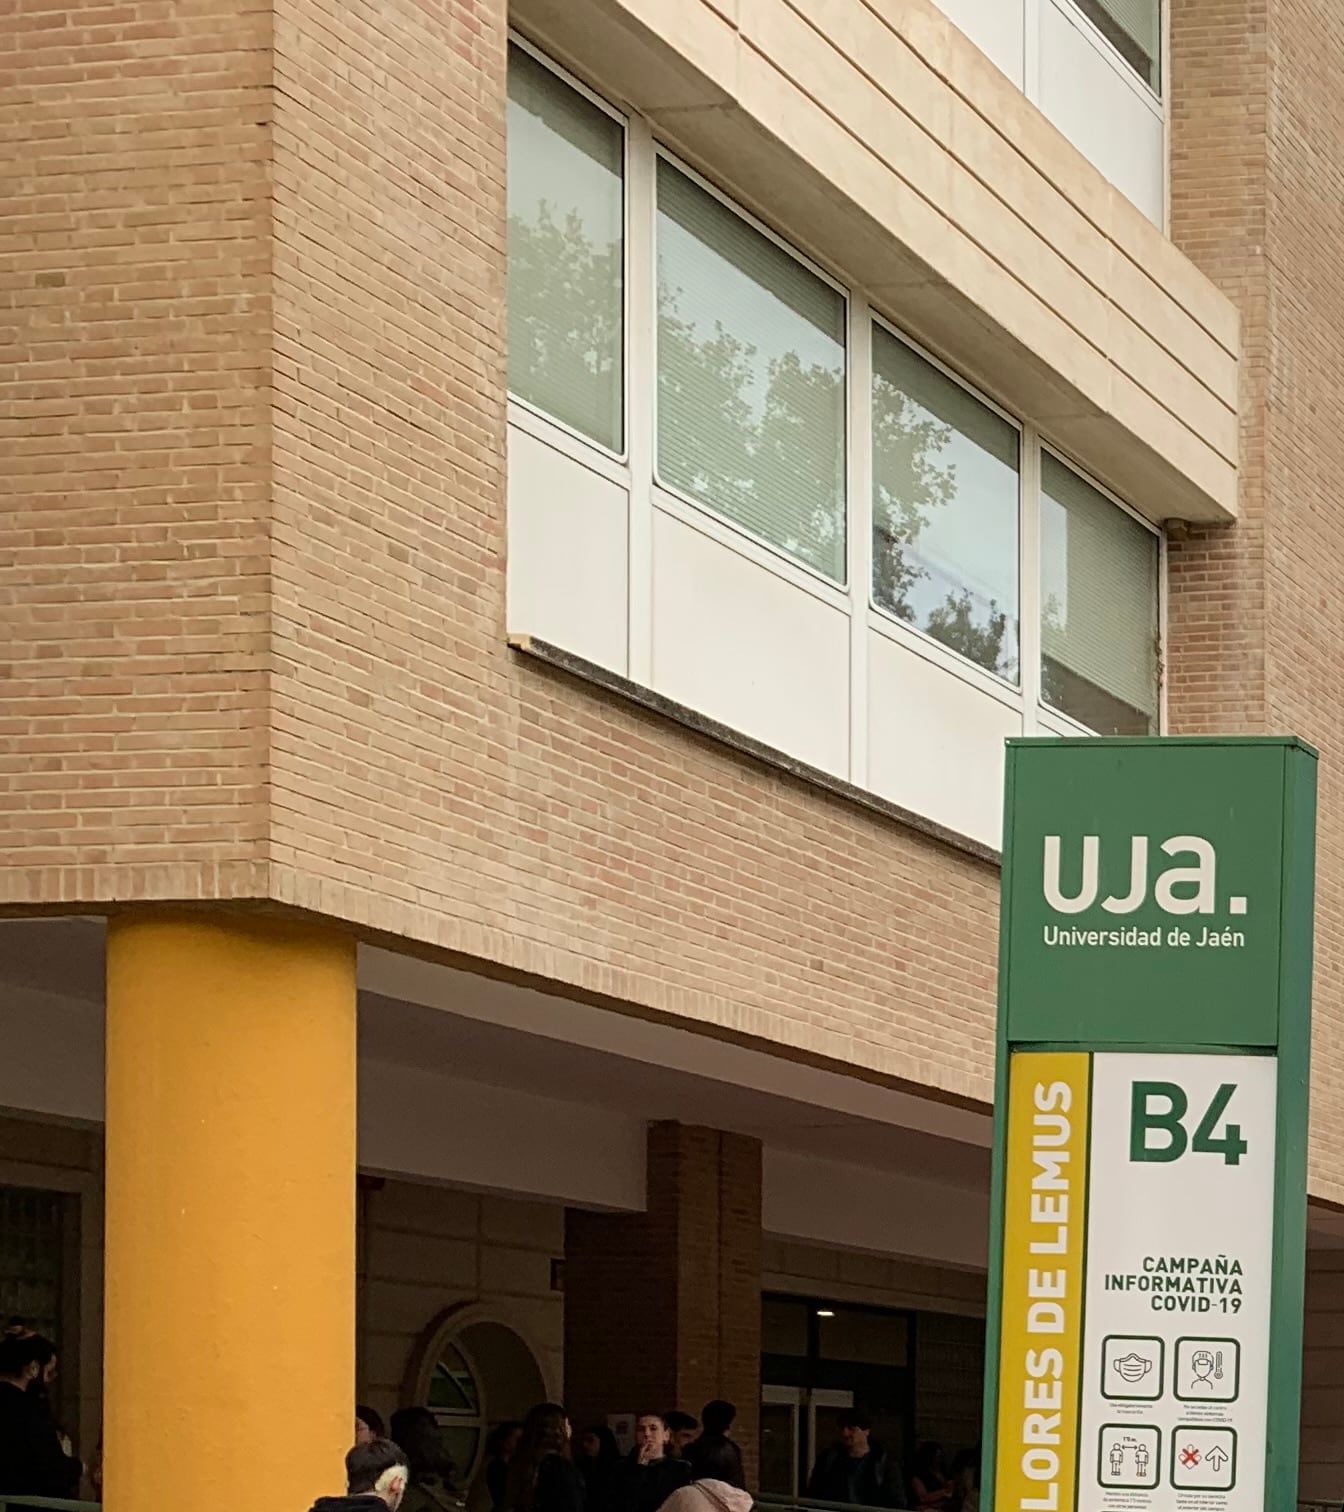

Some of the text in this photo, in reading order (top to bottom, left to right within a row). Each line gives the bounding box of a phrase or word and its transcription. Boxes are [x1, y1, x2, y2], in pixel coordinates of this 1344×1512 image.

[1043, 925, 1245, 948] Universidad de Jaén
[1129, 1080, 1248, 1166] B4
[1029, 1081, 1072, 1255] LEMUS
[1142, 1254, 1243, 1276] CAMPAÑA
[1104, 1274, 1243, 1295] INFORMATIVA
[1027, 1269, 1067, 1334] DE
[1151, 1295, 1242, 1314] COVID-19
